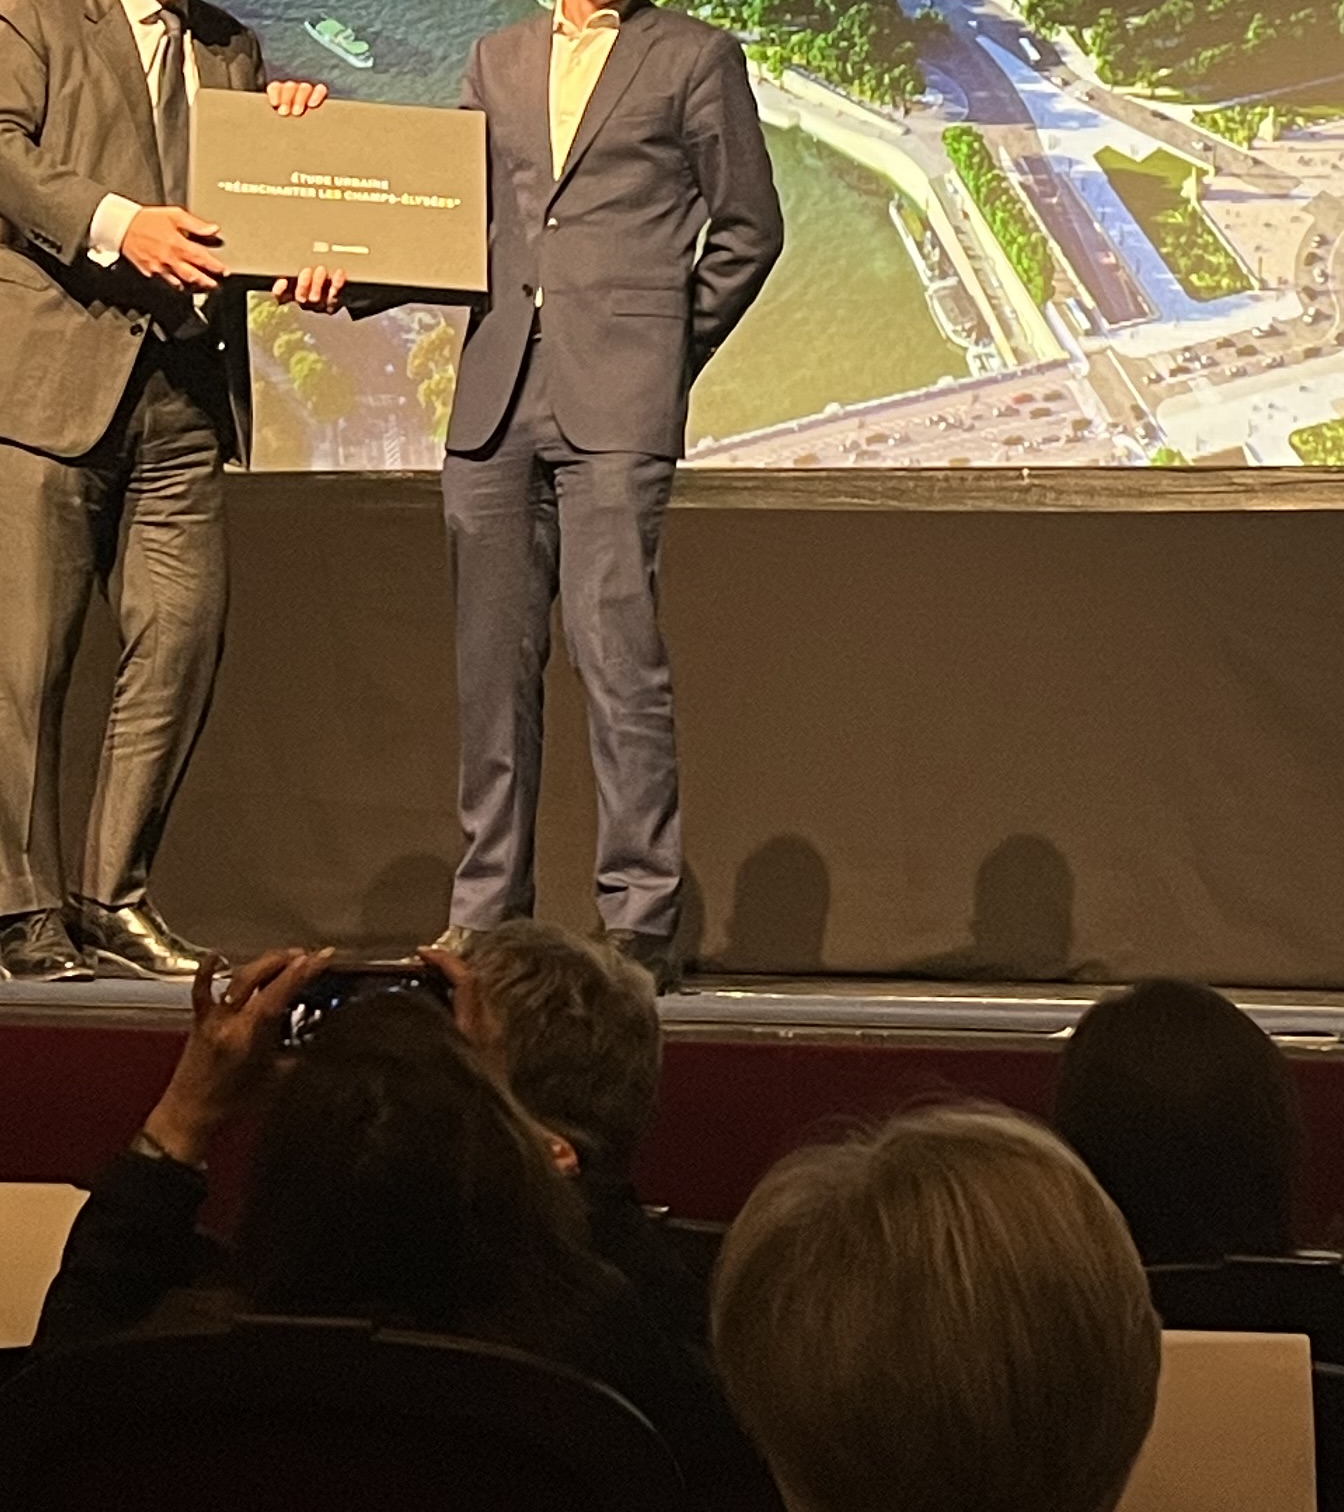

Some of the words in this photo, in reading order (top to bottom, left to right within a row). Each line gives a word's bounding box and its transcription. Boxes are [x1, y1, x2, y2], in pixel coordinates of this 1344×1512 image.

[290, 171, 331, 186] ÉTUDE
[333, 175, 389, 190] URBAINE
[318, 188, 342, 200] LES
